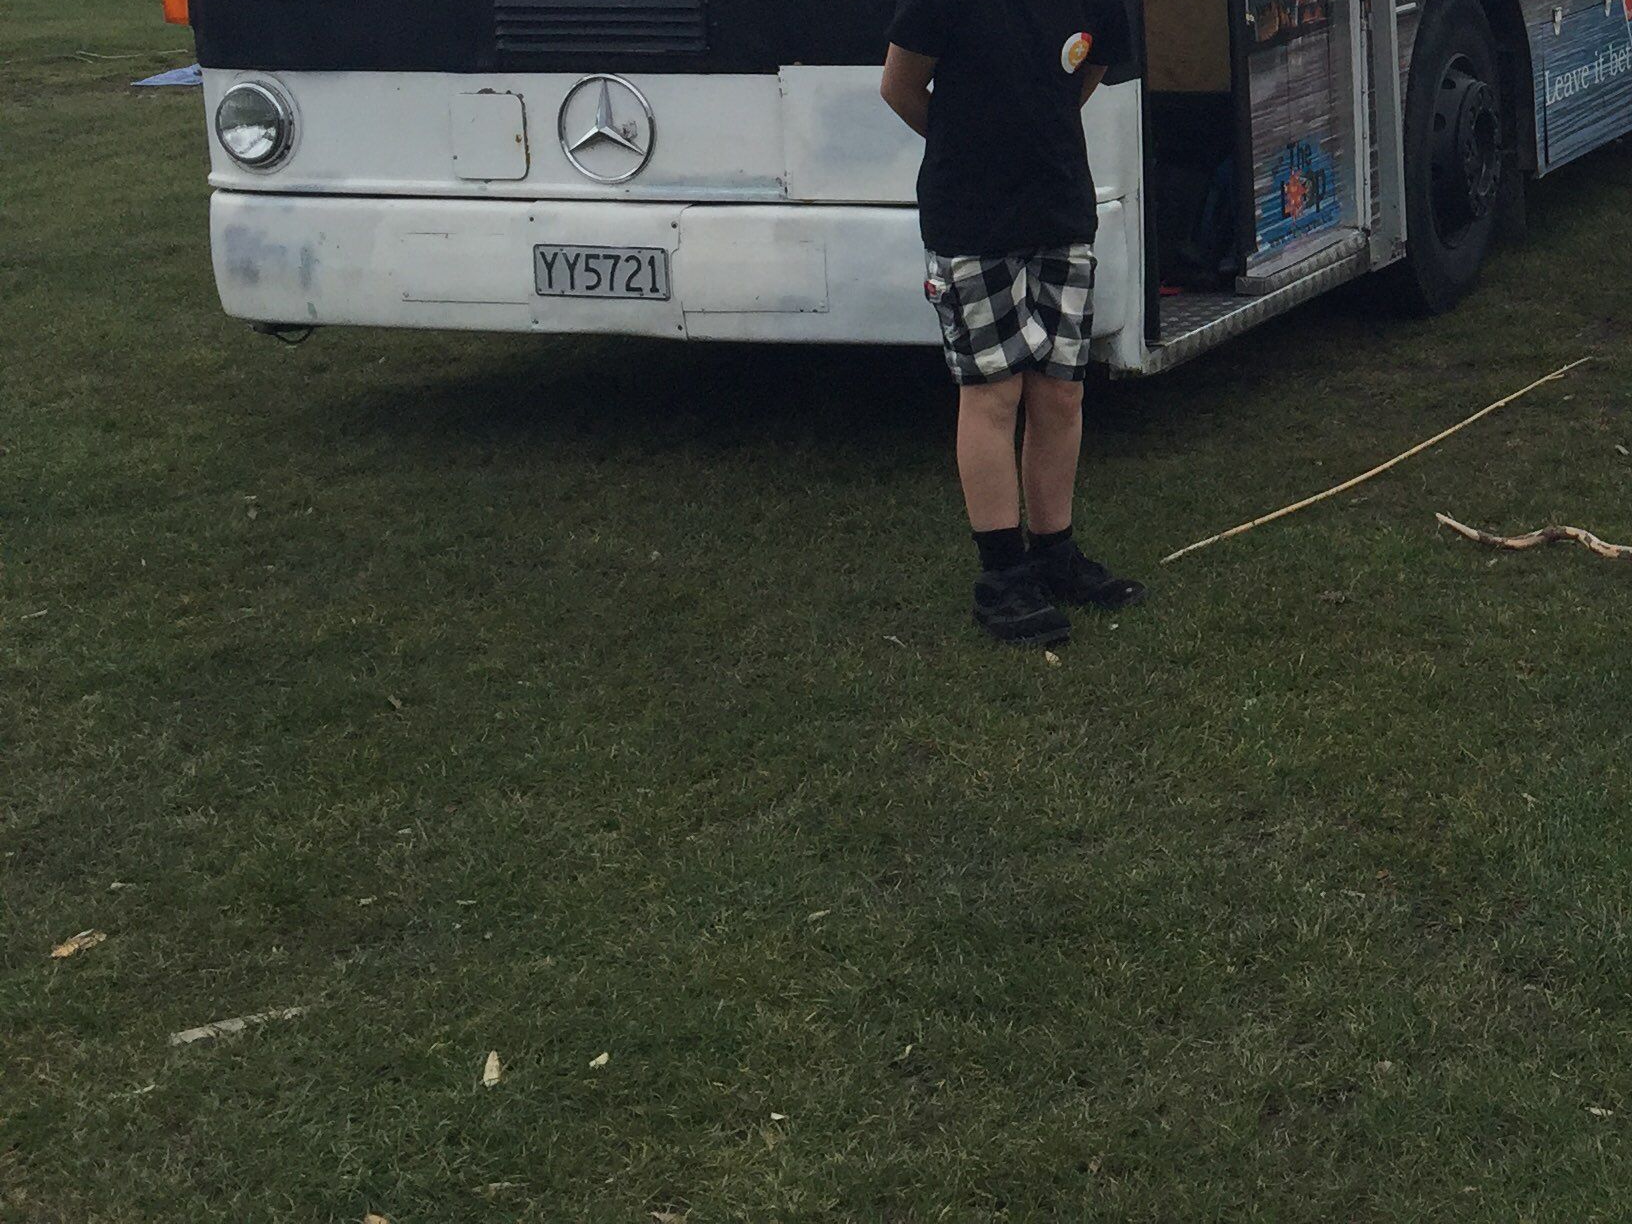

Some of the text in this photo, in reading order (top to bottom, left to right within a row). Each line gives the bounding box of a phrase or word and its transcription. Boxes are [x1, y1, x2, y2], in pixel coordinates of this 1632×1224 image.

[1545, 65, 1589, 106] Leave
[1595, 51, 1606, 82] it
[539, 251, 660, 294] YY5721
